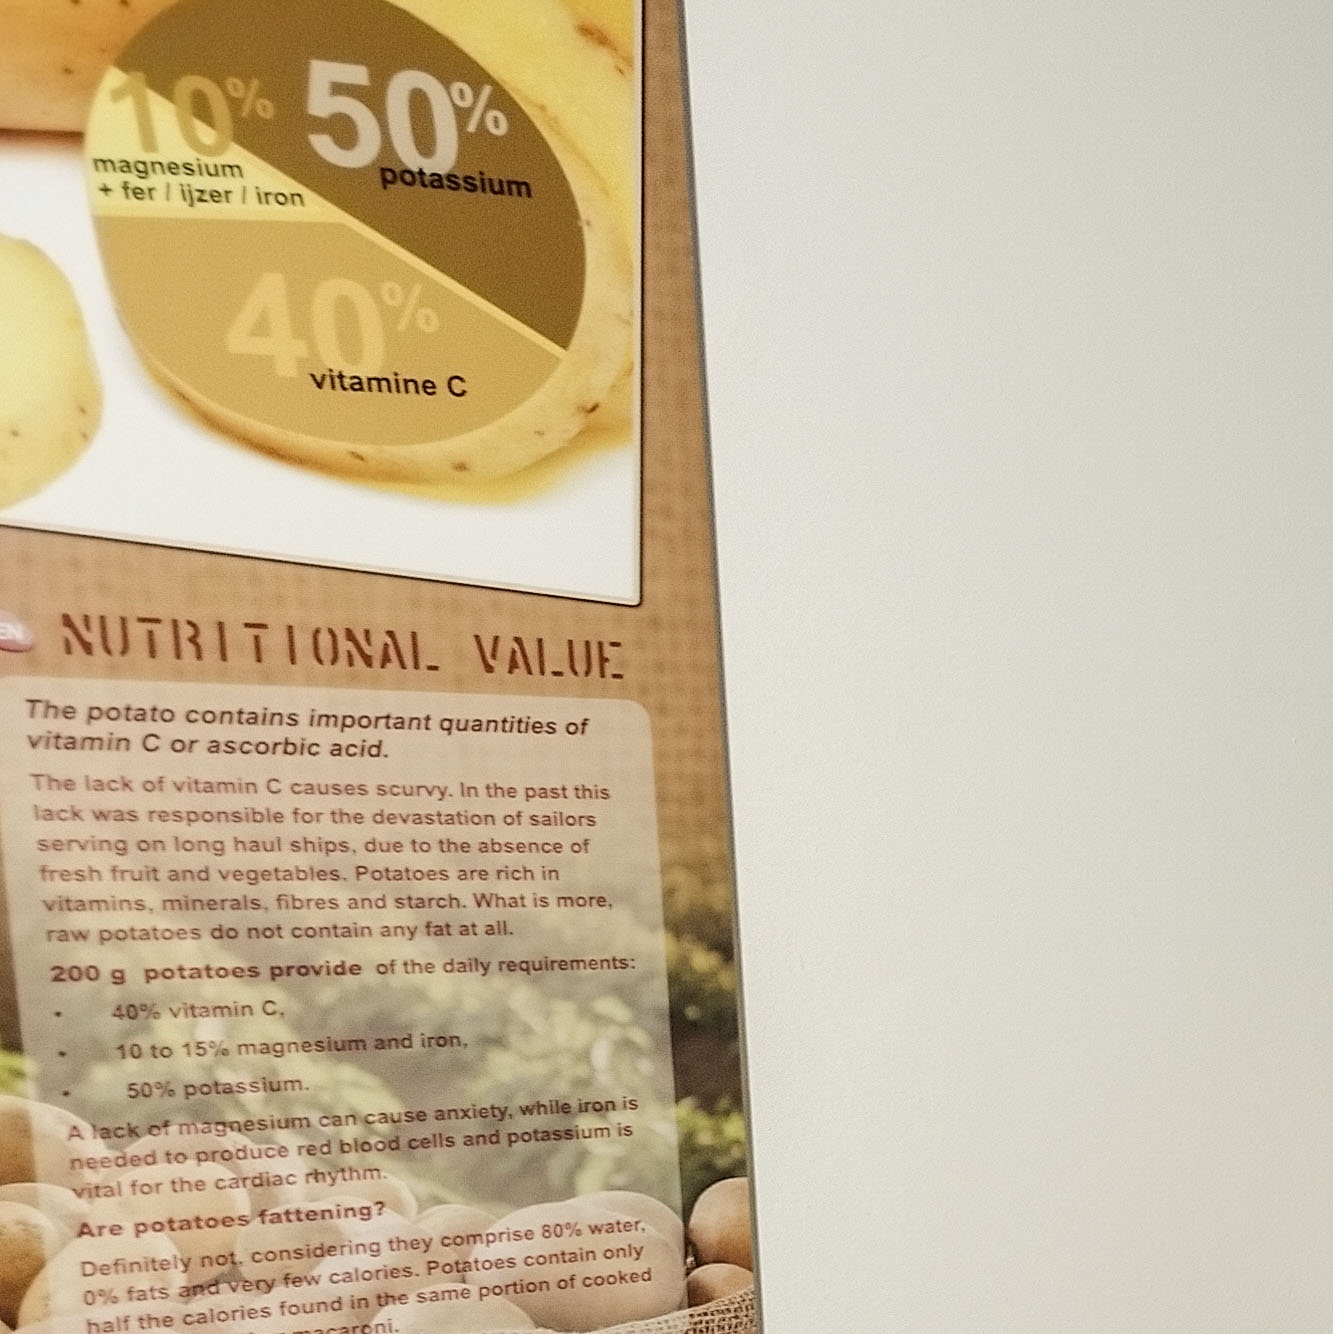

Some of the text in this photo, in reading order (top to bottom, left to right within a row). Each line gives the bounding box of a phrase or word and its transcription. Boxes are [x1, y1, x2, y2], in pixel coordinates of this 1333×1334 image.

[110, 70, 275, 158] 10%
[306, 59, 509, 175] 50%
[93, 156, 244, 181] magnesium
[380, 165, 533, 200] potassium
[122, 180, 156, 202] fer
[180, 183, 232, 207] ijzer
[255, 185, 305, 207] iron
[225, 272, 440, 378] 40%
[309, 368, 468, 398] vitamine C
[61, 612, 625, 680] NUTRITIONAL VALUE
[25, 698, 590, 736] The potato contains important quantities of
[27, 732, 389, 759] vitamin C or ascorbic acid.
[29, 773, 611, 803] The lack of vitamin C causes scurvy. In the past this
[33, 804, 597, 828] lack was responsible for the devastation of sailors
[50, 955, 636, 986] 200 g potatoes provide of the daily requirements:
[111, 999, 286, 1021] 40% vitamin C,
[115, 1032, 468, 1060] 10 to 15% magnesium and iron,
[127, 1075, 309, 1101] 50% potassium.
[74, 1200, 387, 1239] Are potatoes fattening?
